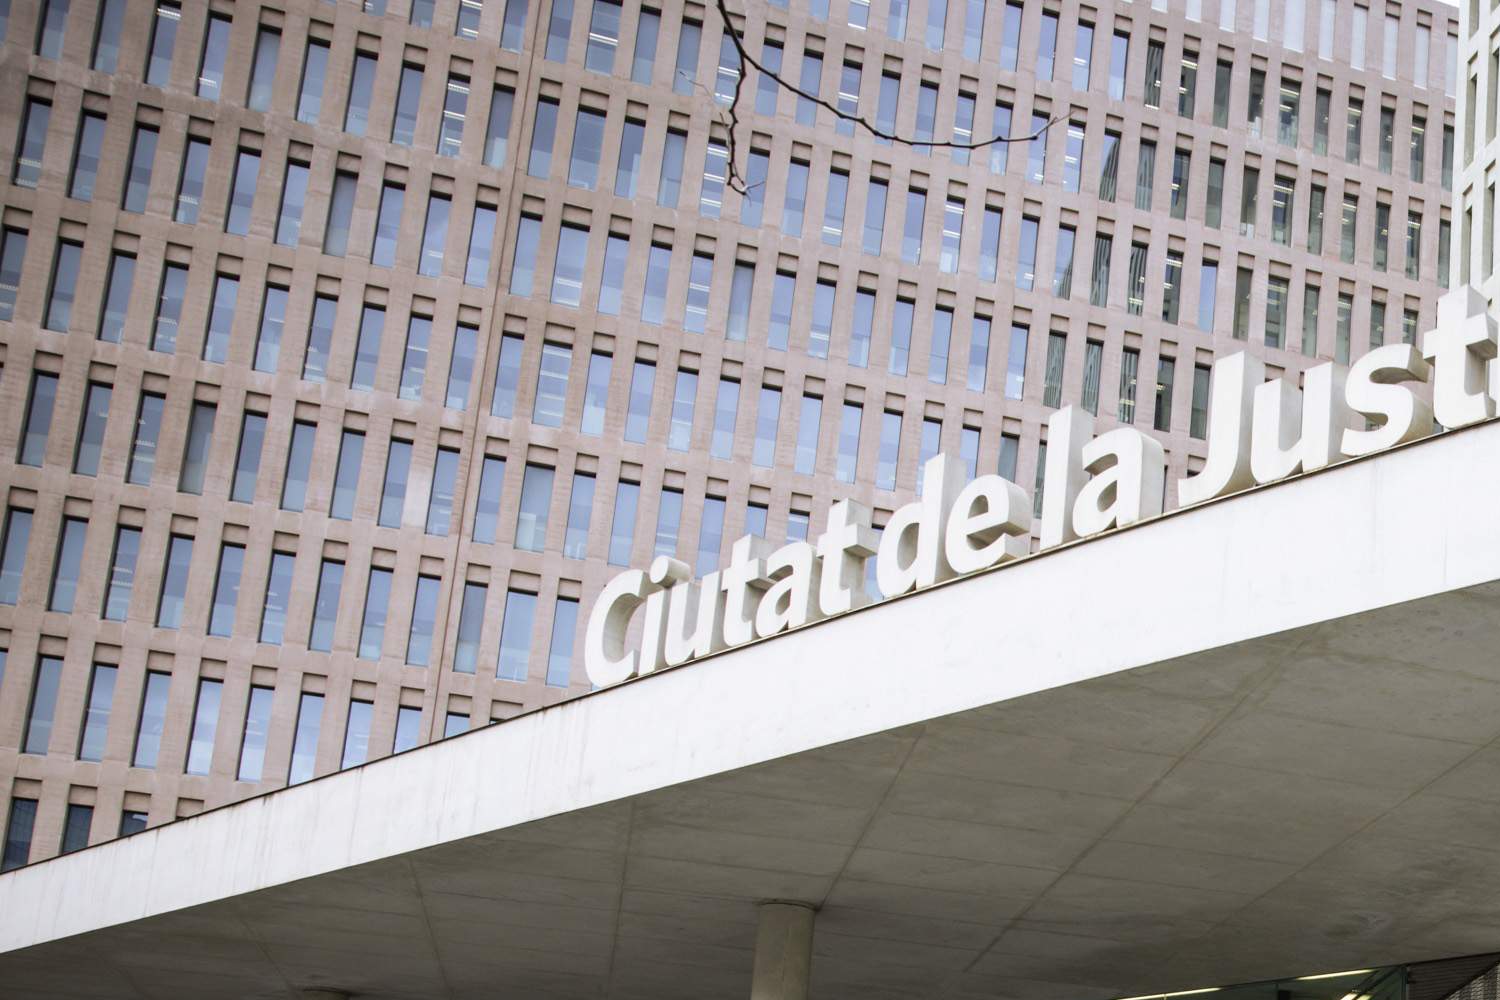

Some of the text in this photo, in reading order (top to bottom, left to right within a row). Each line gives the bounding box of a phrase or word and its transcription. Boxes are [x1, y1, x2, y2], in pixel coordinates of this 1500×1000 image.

[584, 497, 876, 687] Ciutat
[876, 453, 1030, 598] de
[1041, 405, 1163, 550] la
